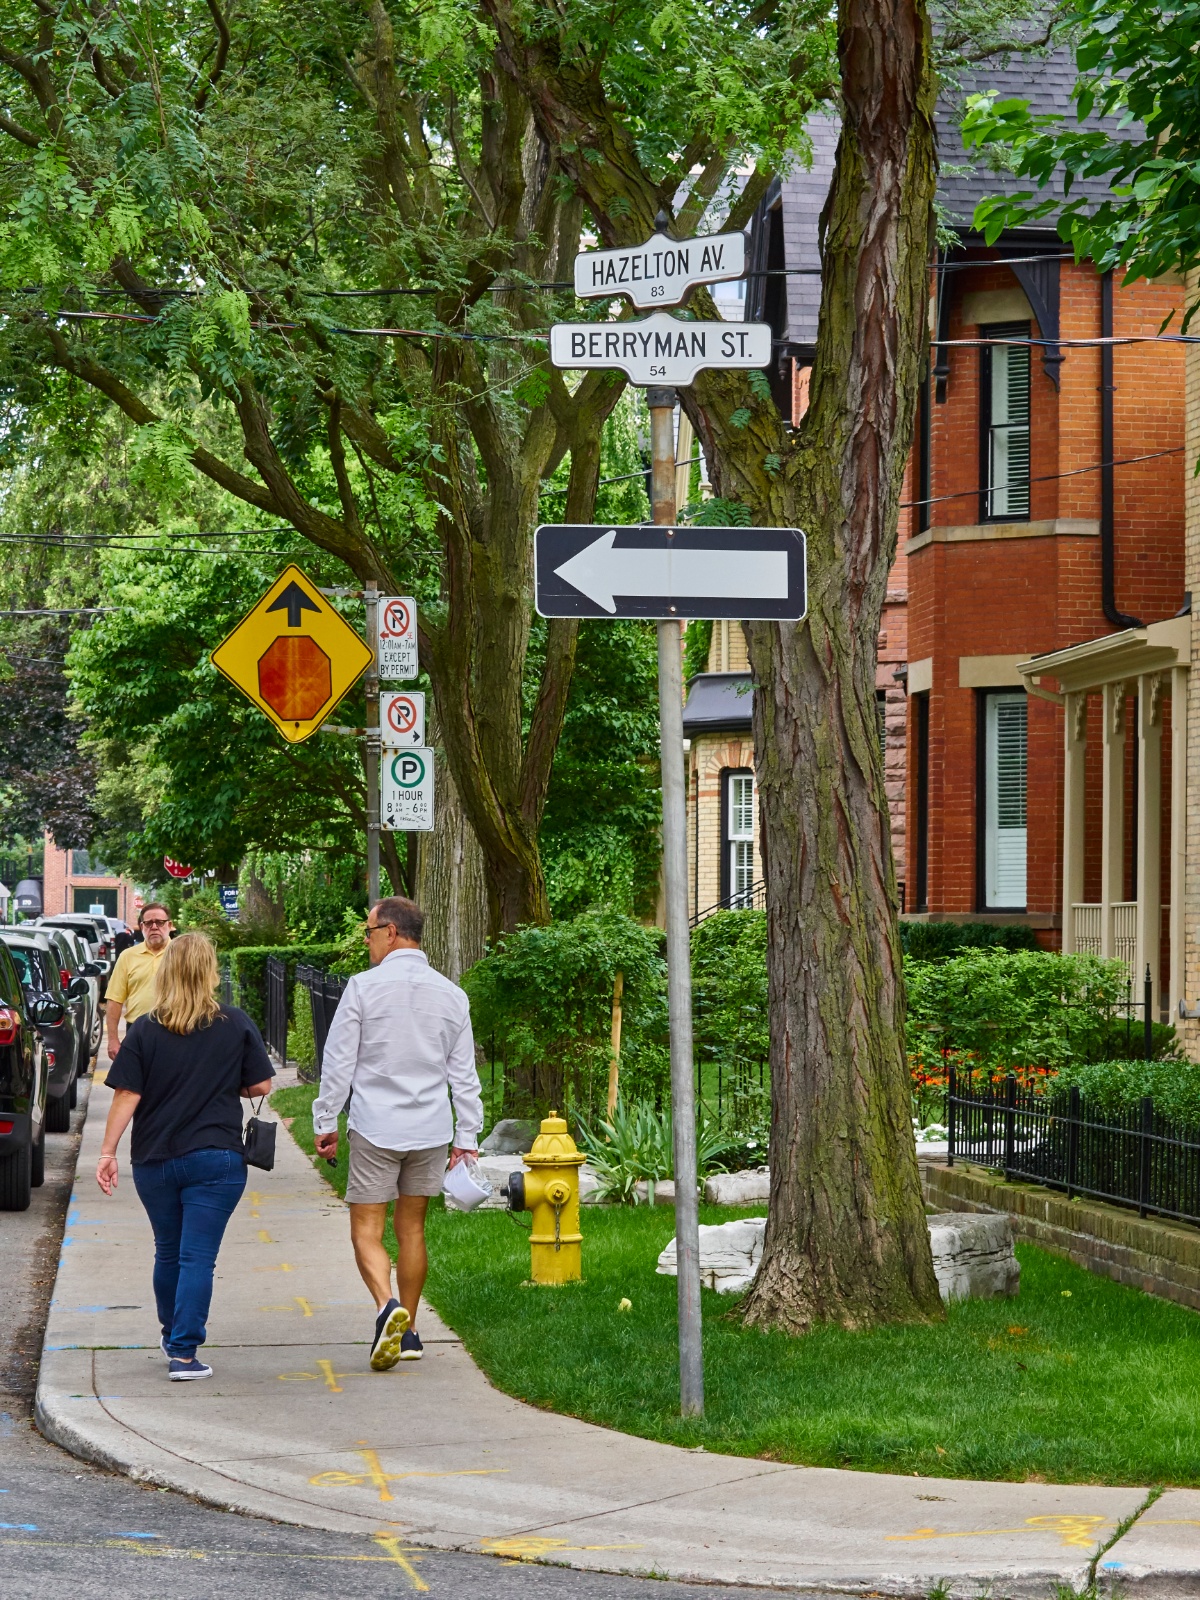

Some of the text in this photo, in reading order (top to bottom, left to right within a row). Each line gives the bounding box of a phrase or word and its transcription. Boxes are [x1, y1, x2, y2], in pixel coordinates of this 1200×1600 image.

[592, 244, 725, 286] HAZELTON AV.
[651, 286, 665, 297] 83
[571, 332, 752, 358] BERRYMAN ST.
[649, 366, 666, 376] 54
[384, 652, 411, 662] EXCEPT
[380, 664, 415, 675] BY PERMIT
[402, 761, 418, 780] P
[398, 790, 423, 801] HOUR
